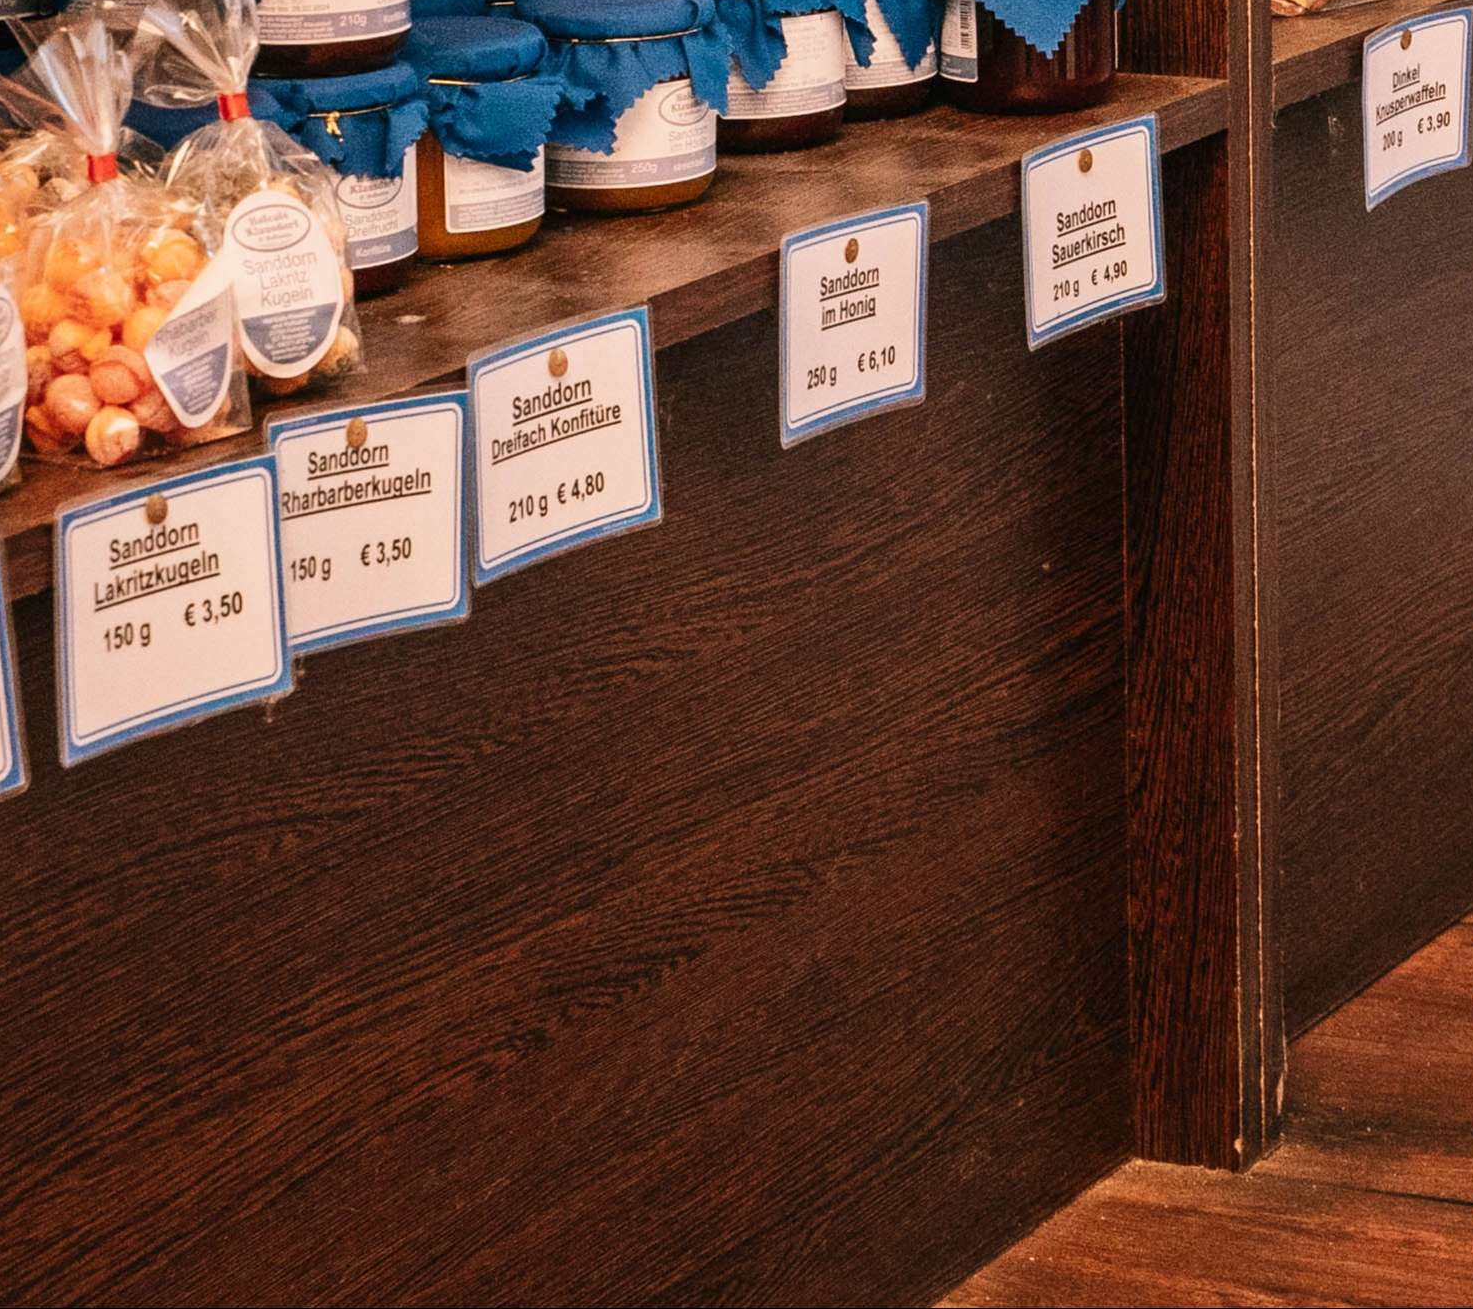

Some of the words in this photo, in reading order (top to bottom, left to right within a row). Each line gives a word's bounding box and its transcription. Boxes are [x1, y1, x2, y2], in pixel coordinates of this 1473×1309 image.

[339, 10, 368, 27] 210g
[1391, 63, 1421, 90] Dinkel
[1374, 81, 1447, 124] Knusperwaffeln
[630, 161, 659, 174] 250g
[1056, 198, 1117, 232] Sanddorn
[241, 249, 319, 277] Sanddorn
[1051, 222, 1126, 265] Sauerkirsch
[259, 285, 315, 308] Kugeln
[260, 269, 308, 292] Lakritz
[819, 263, 880, 297] Sanddorn
[1052, 280, 1071, 302] 210
[1072, 280, 1080, 299] g
[1091, 269, 1099, 287] €
[1103, 260, 1129, 283] 4,90
[821, 303, 836, 325] im
[839, 295, 877, 323] Honig
[806, 366, 827, 391] 250
[829, 366, 838, 388] g
[857, 353, 866, 373] €
[867, 345, 896, 372] 6,10
[511, 376, 593, 420] Sanddorn
[490, 417, 548, 462] Dreifach
[549, 398, 623, 446] Konfitüre
[306, 440, 391, 475] Sanddorn
[281, 466, 433, 520] Rharbarberkugeln
[508, 494, 536, 525] 210
[537, 493, 550, 522] g
[556, 481, 568, 508] €
[568, 472, 607, 506] 4,80
[108, 517, 201, 564] Sanddorn
[289, 554, 317, 582] 150
[320, 558, 332, 583] g
[360, 543, 373, 568] €
[375, 536, 414, 569] 3,50
[94, 548, 221, 610] Lakritzkugeln
[103, 622, 135, 654] 150
[139, 620, 152, 650] g
[183, 602, 197, 628] €
[201, 588, 245, 626] 3,50
